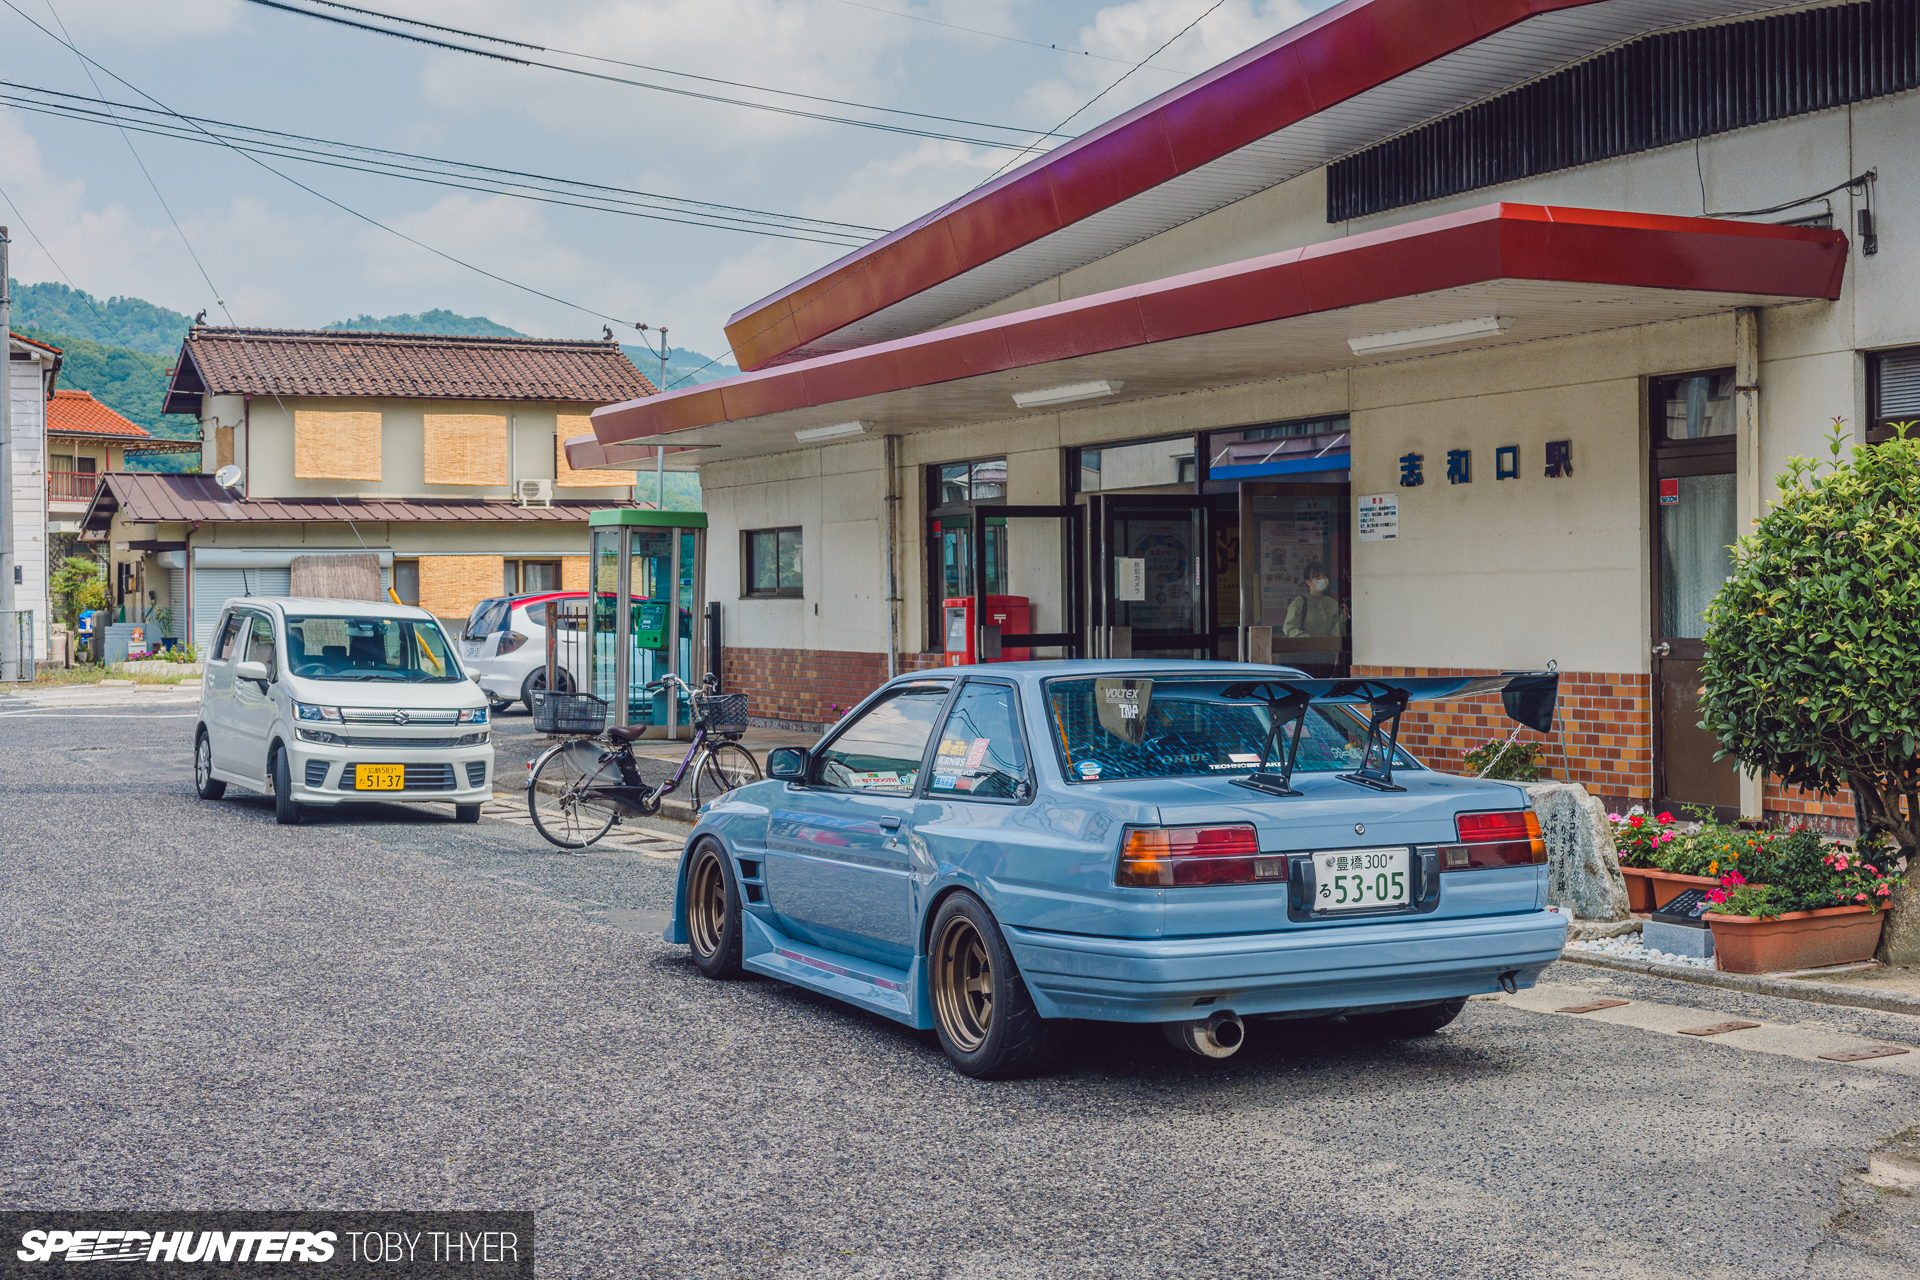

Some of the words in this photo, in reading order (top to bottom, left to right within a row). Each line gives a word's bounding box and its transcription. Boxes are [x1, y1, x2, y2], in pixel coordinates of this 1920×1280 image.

[1399, 440, 1573, 487] 志和口駅
[1105, 688, 1139, 699] VOLTEX
[367, 775, 401, 787] 51-37
[1568, 808, 1577, 857] ネコ駅長
[1319, 883, 1331, 899] る
[1334, 871, 1405, 904] 53-05
